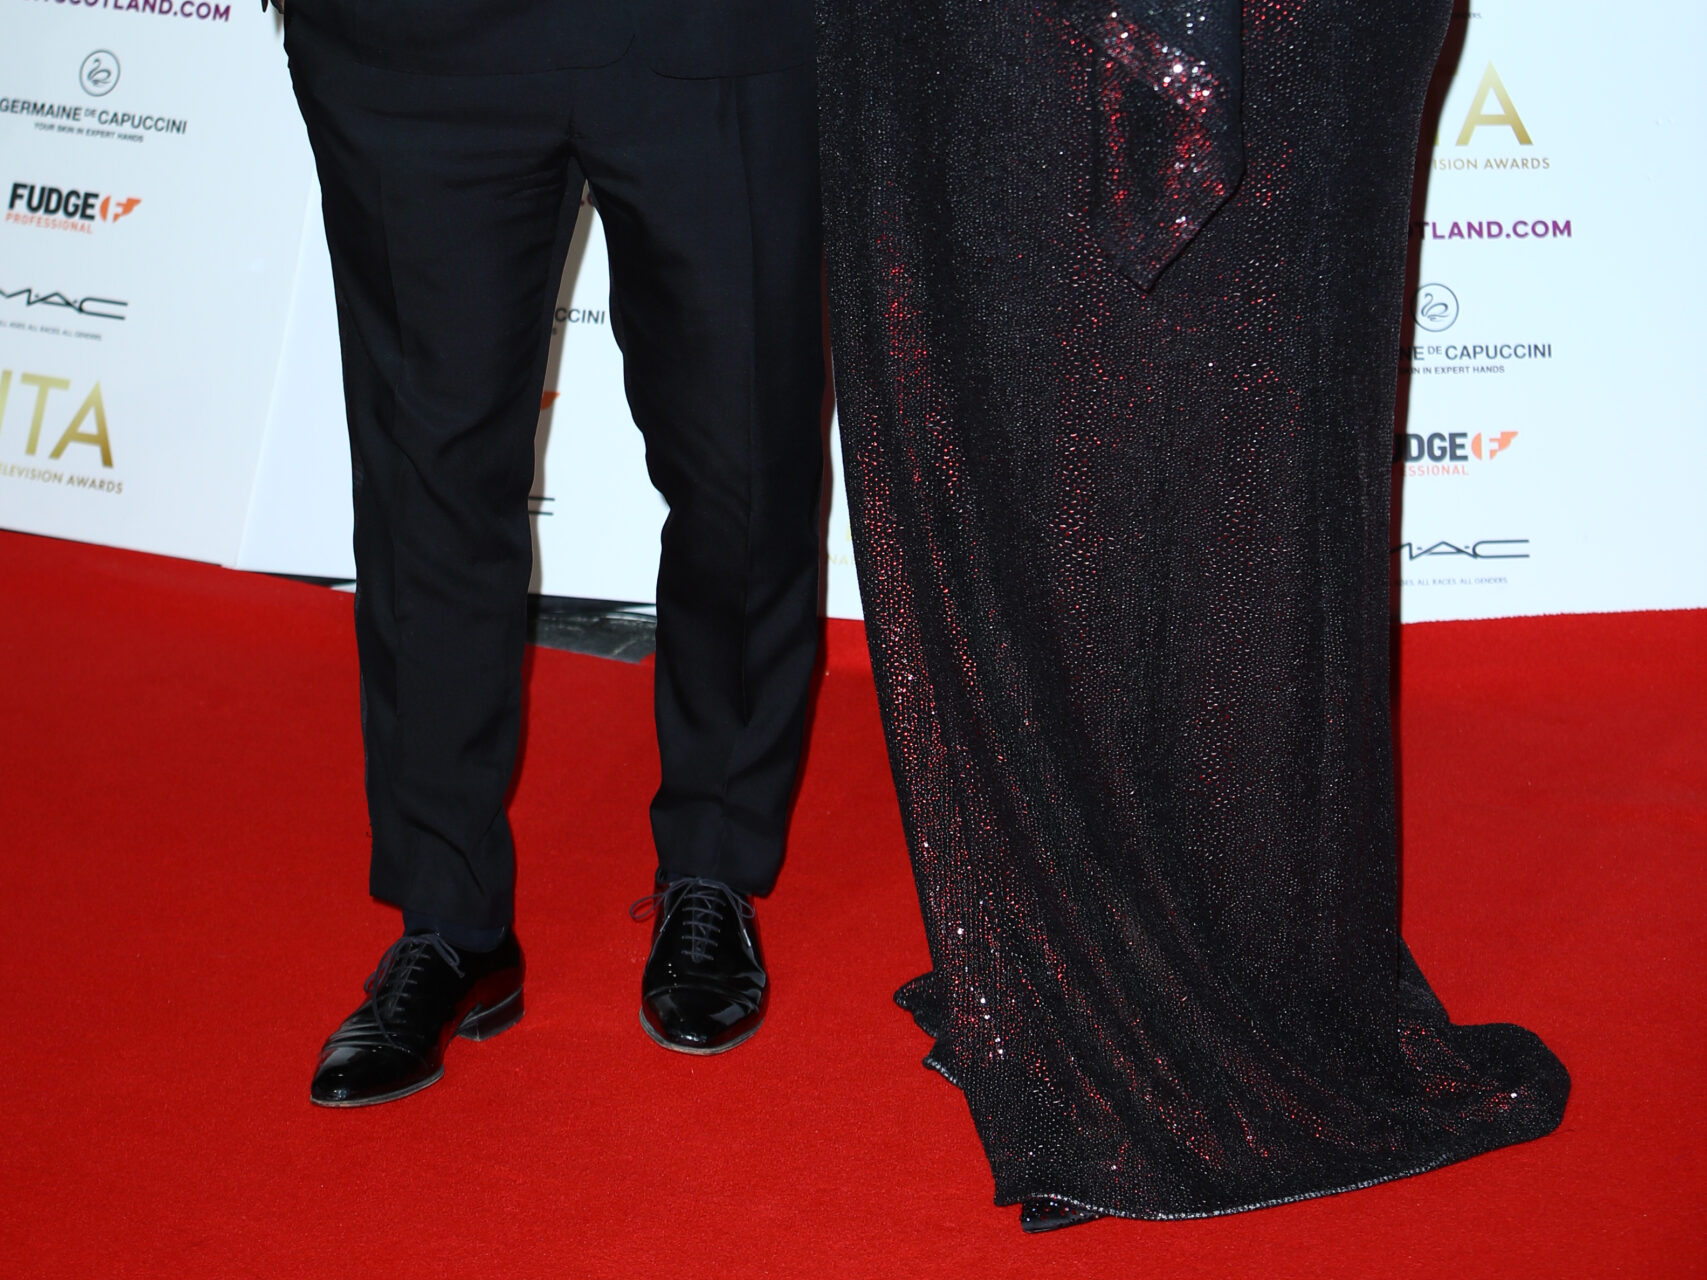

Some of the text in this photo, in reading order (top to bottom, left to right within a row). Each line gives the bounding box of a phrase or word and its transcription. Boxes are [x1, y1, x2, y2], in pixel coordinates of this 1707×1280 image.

[0, 97, 188, 135] GERMAINE DE CAPUCCINI
[34, 122, 55, 132] YOUR
[86, 128, 116, 139] EXPERT
[1484, 157, 1550, 170] AWARDS
[8, 182, 100, 221] FUDGE
[5, 212, 94, 234] PROFESSIONAL
[1409, 220, 1572, 239] TLAND.COM
[555, 307, 605, 325] CCINI
[1428, 346, 1442, 355] DE
[1445, 344, 1552, 361] CAPUCCINI
[1423, 367, 1432, 375] IN
[1435, 366, 1470, 375] EXPERT
[1473, 365, 1505, 374] HANDS
[1406, 464, 1469, 477] SSIONAL
[66, 474, 123, 494] AWARDS
